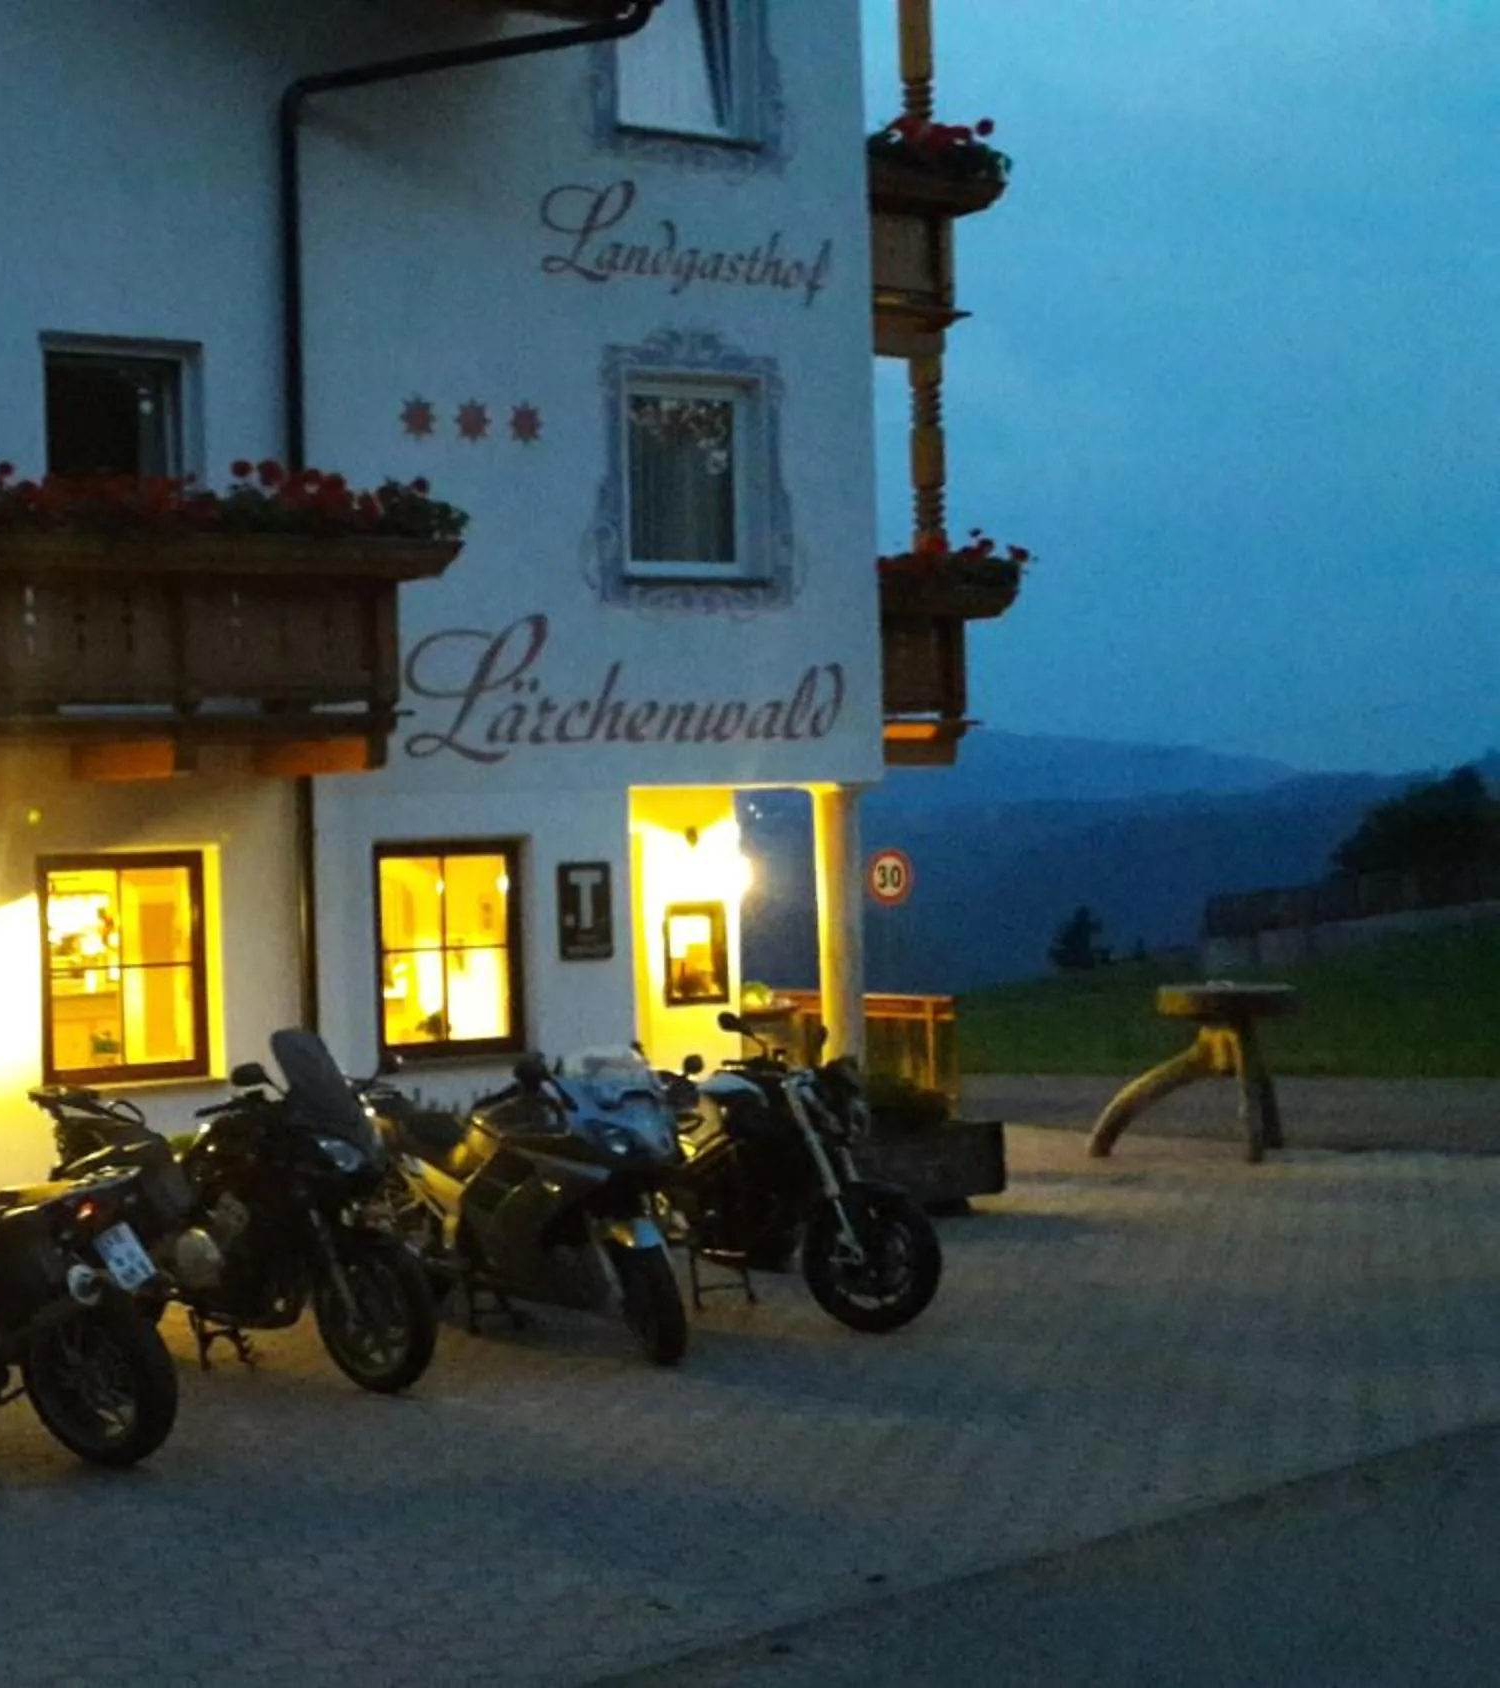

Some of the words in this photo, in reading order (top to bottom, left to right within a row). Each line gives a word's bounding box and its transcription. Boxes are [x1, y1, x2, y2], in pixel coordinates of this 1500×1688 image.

[540, 179, 833, 306] Landgasthof
[404, 613, 845, 764] Lärchenwald
[568, 869, 602, 929] T
[878, 865, 901, 890] 30
